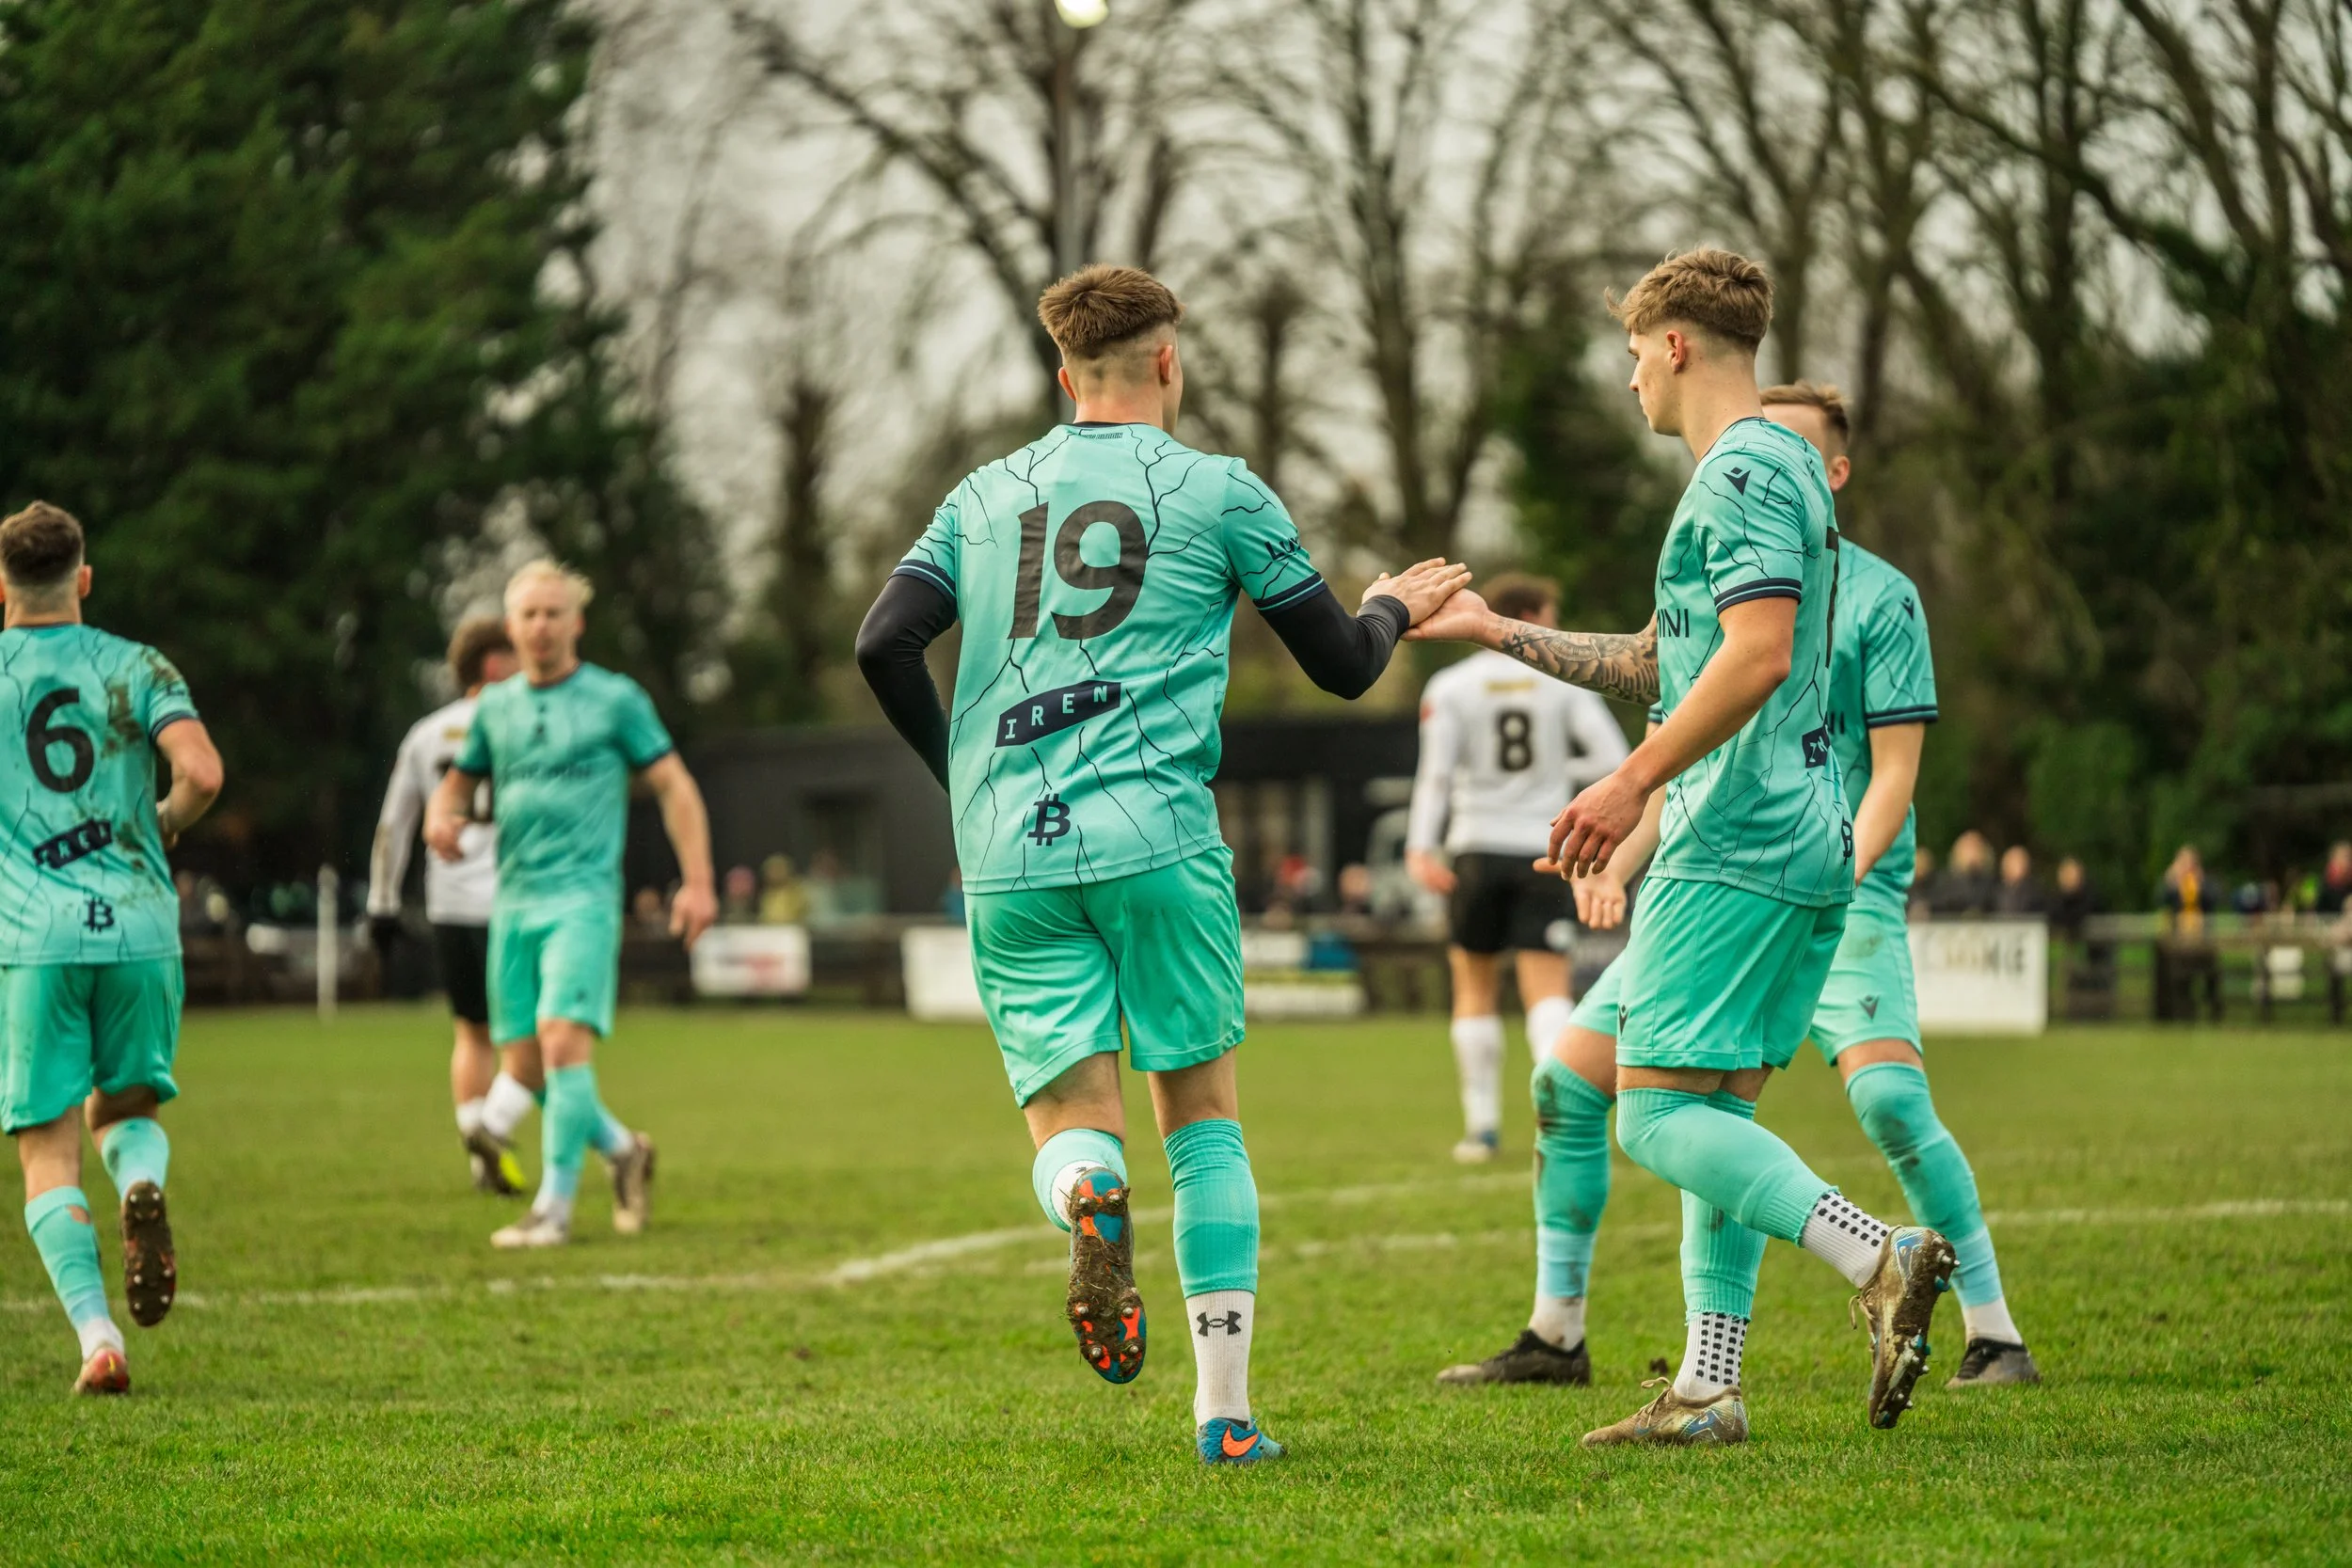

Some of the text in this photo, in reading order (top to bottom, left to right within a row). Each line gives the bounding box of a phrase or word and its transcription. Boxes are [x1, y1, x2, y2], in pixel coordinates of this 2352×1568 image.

[1007, 499, 1147, 641] 19
[26, 687, 94, 794] 6
[1004, 685, 1108, 740] IREN
[1495, 705, 1534, 775] 8
